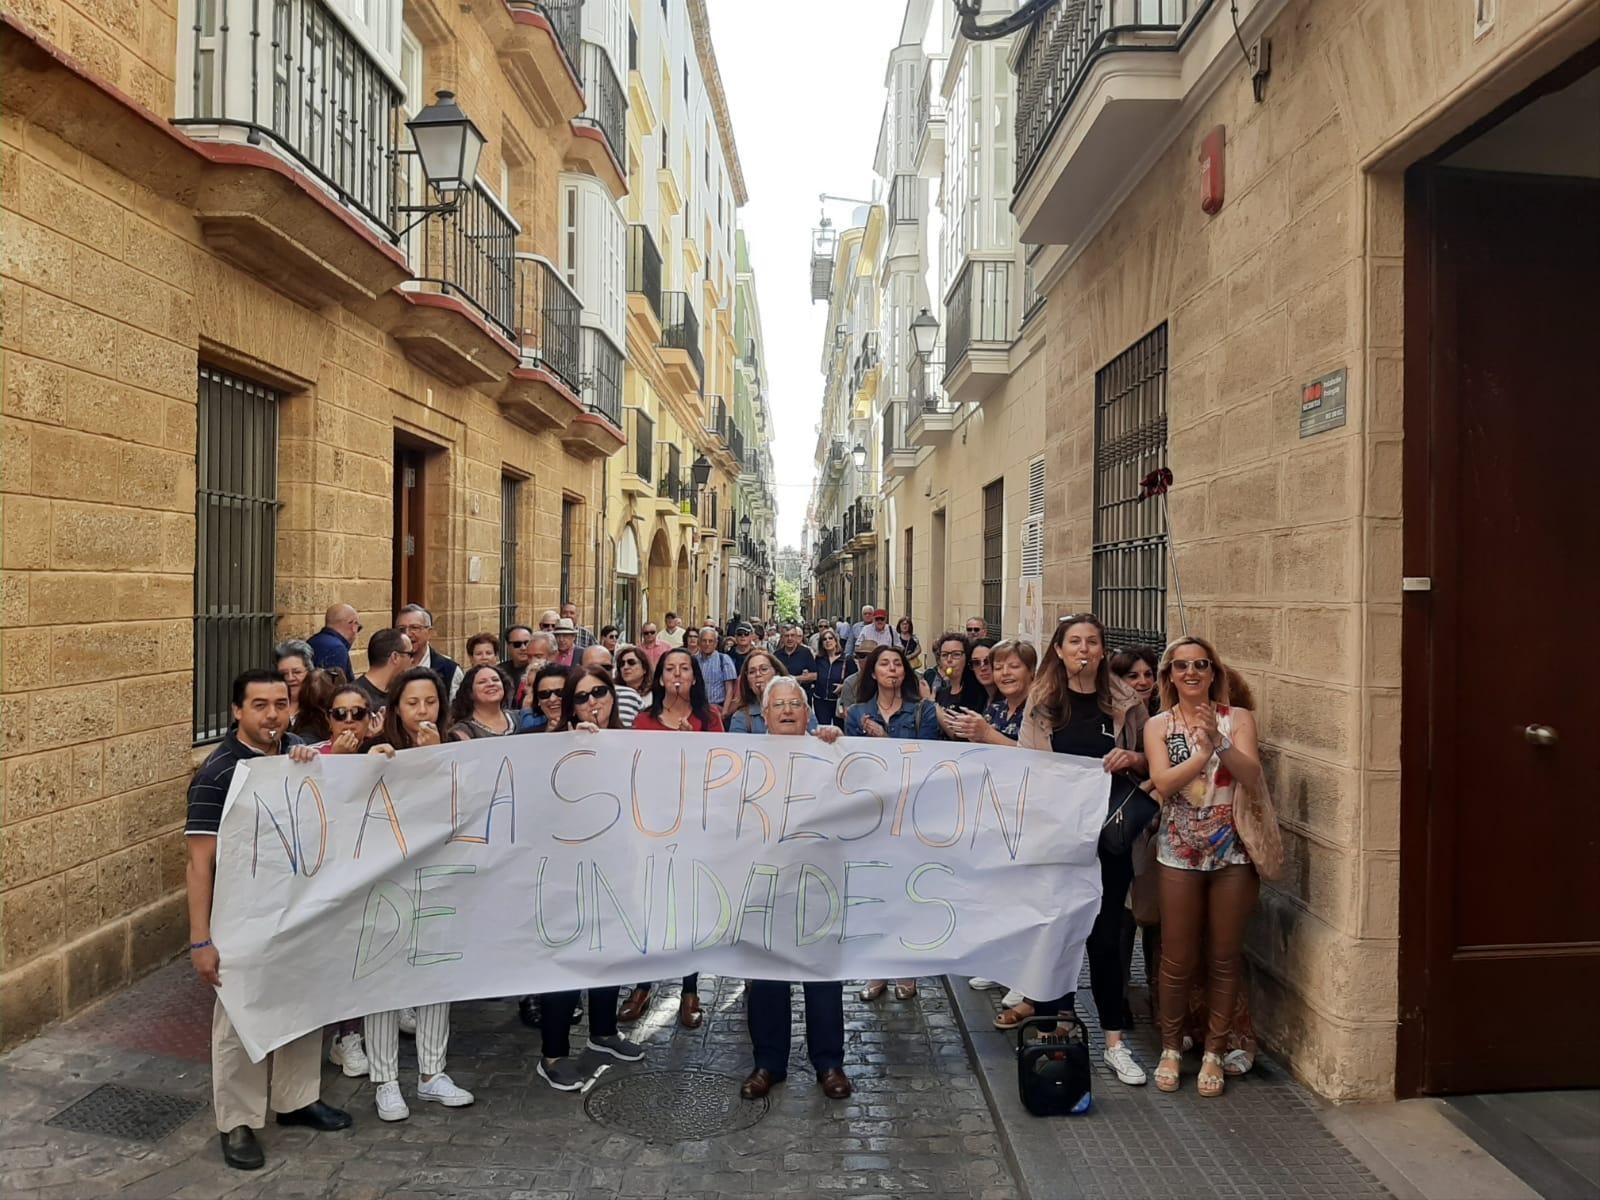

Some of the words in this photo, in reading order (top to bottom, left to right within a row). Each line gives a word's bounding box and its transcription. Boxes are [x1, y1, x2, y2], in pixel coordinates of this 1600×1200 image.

[252, 775, 328, 879] NO
[353, 775, 408, 860] A
[445, 755, 515, 846] LA
[352, 864, 477, 981] DE
